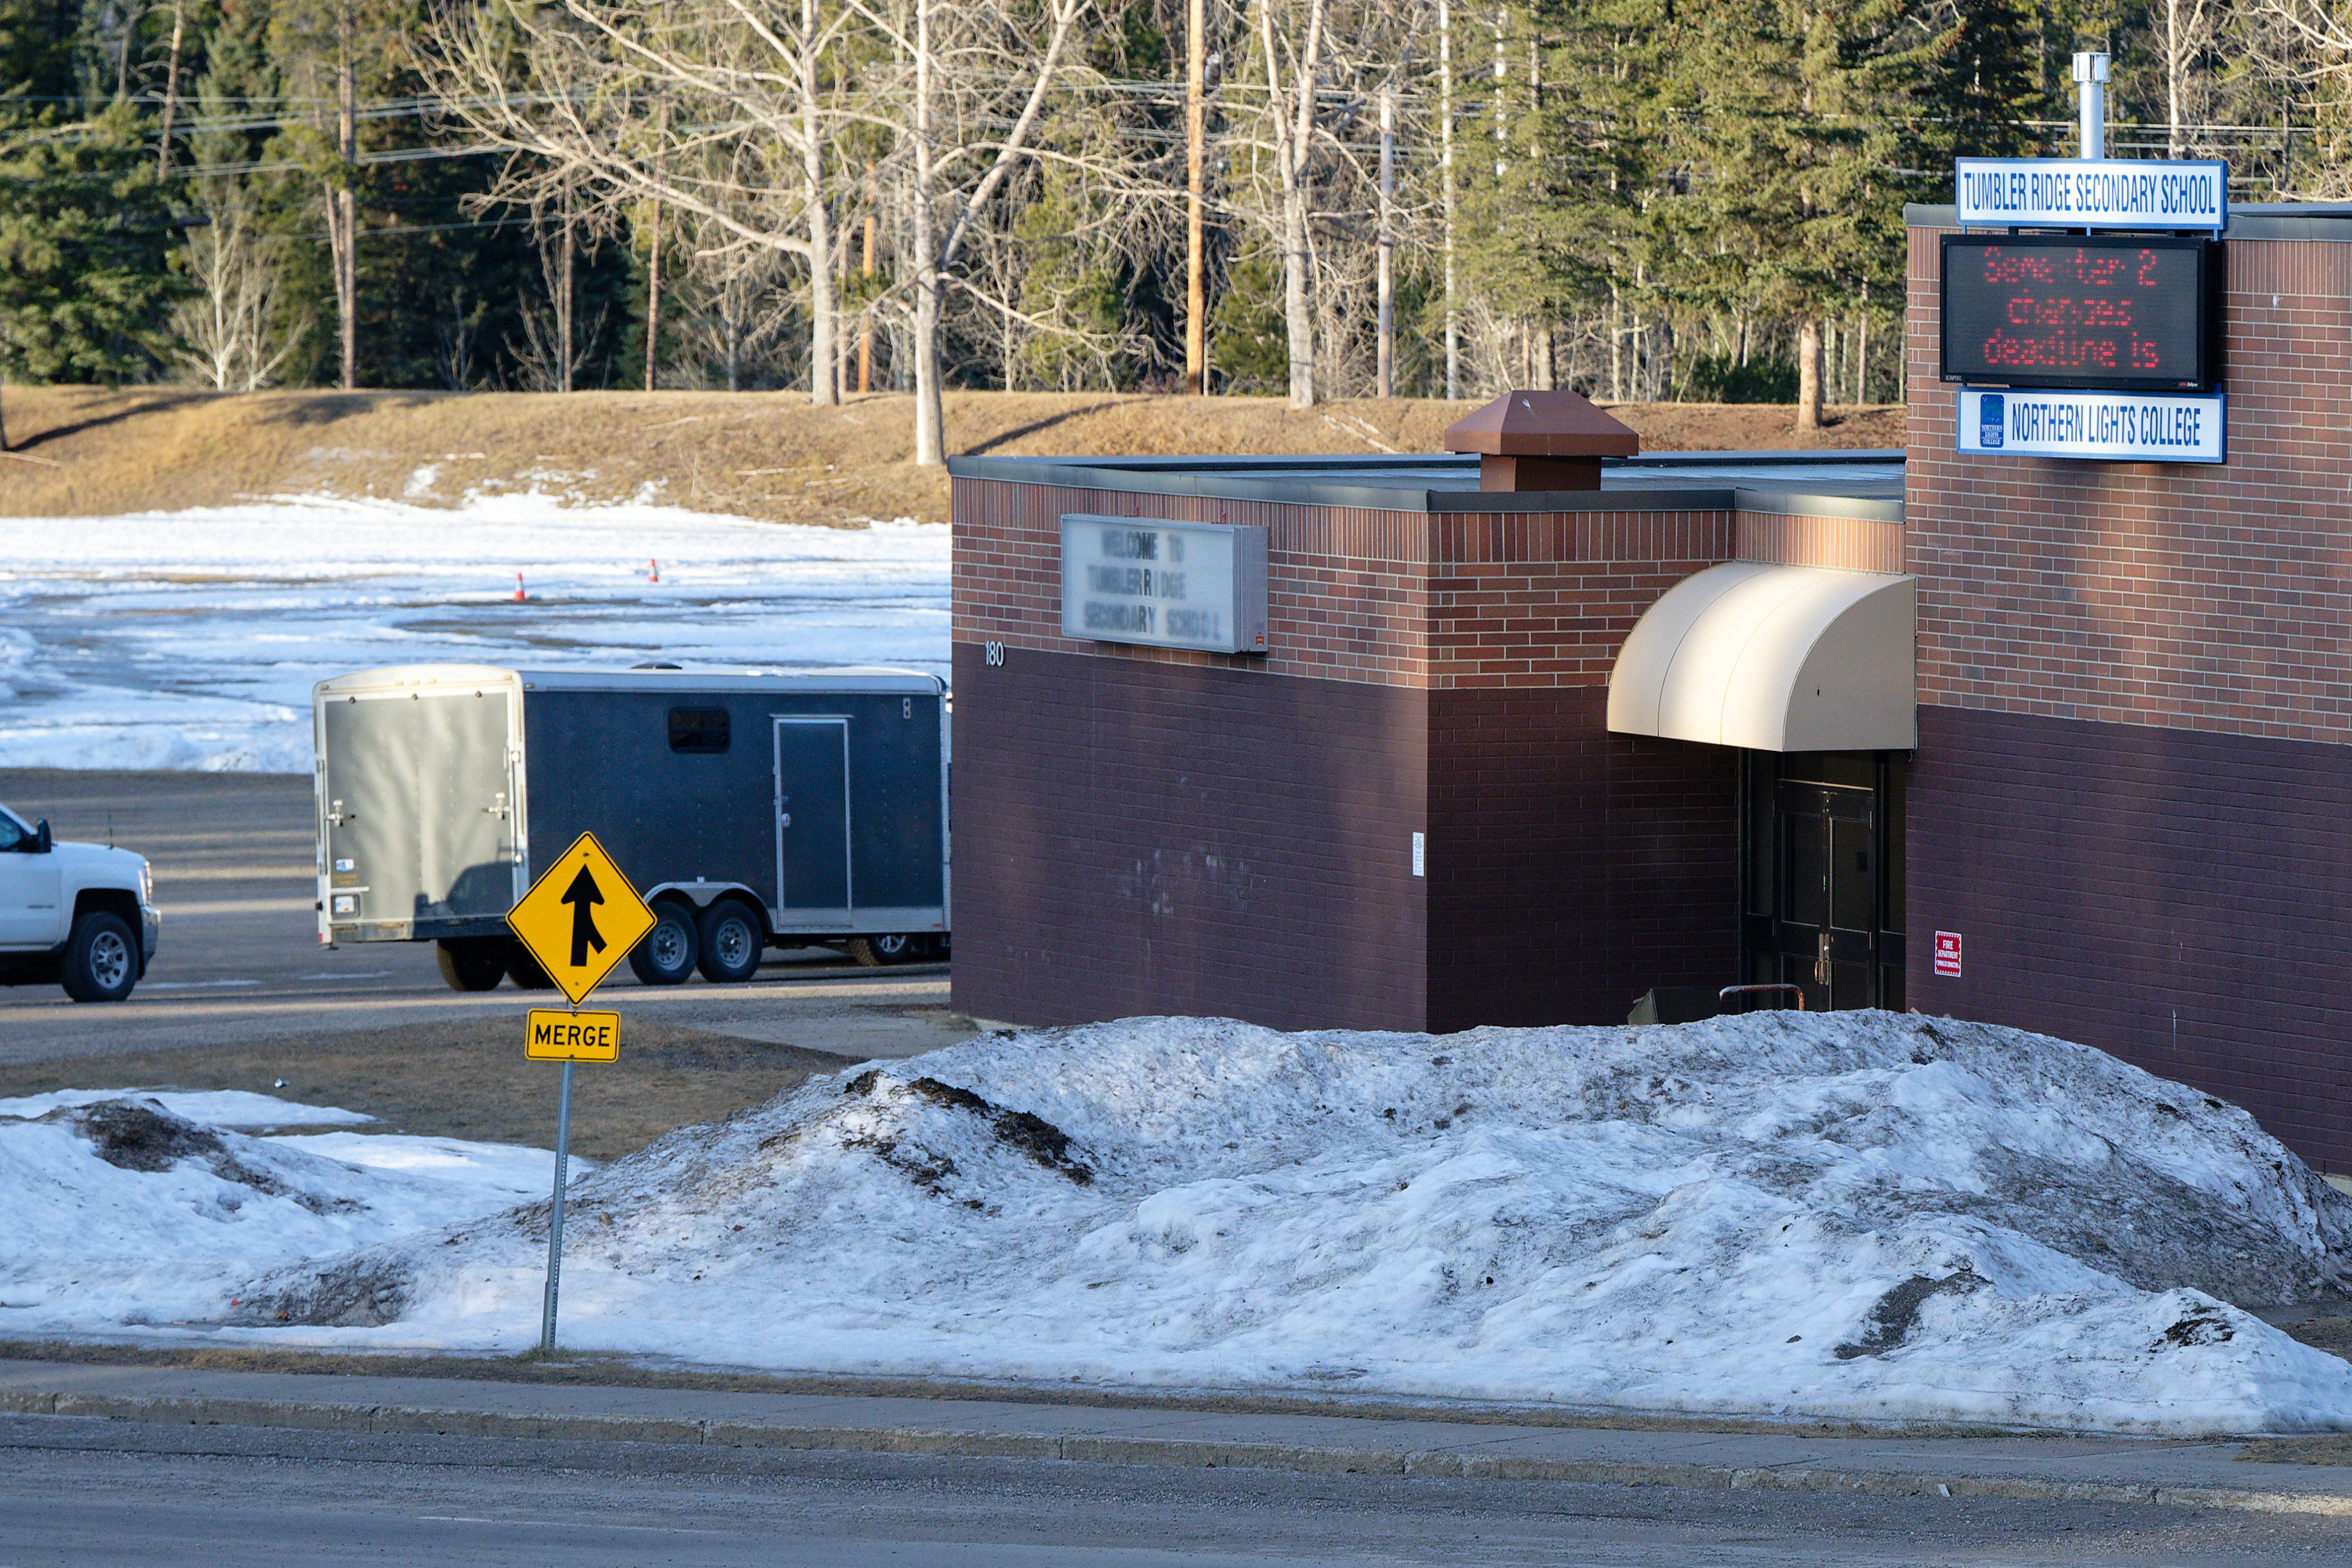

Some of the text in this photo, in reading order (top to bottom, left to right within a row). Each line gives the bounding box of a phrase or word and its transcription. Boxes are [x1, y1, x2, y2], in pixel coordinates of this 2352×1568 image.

[1964, 172, 2216, 214] TUMBLER RIDGE SECONDARY SCHOOL
[1984, 247, 2157, 286] Semeter 2
[1984, 328, 2159, 368] deadline is
[2012, 402, 2201, 446] NORTHERN LIGHTS COLLEGE
[985, 640, 1004, 666] 180
[1943, 939, 1953, 949] FIRE
[535, 1024, 611, 1047] MERGE
